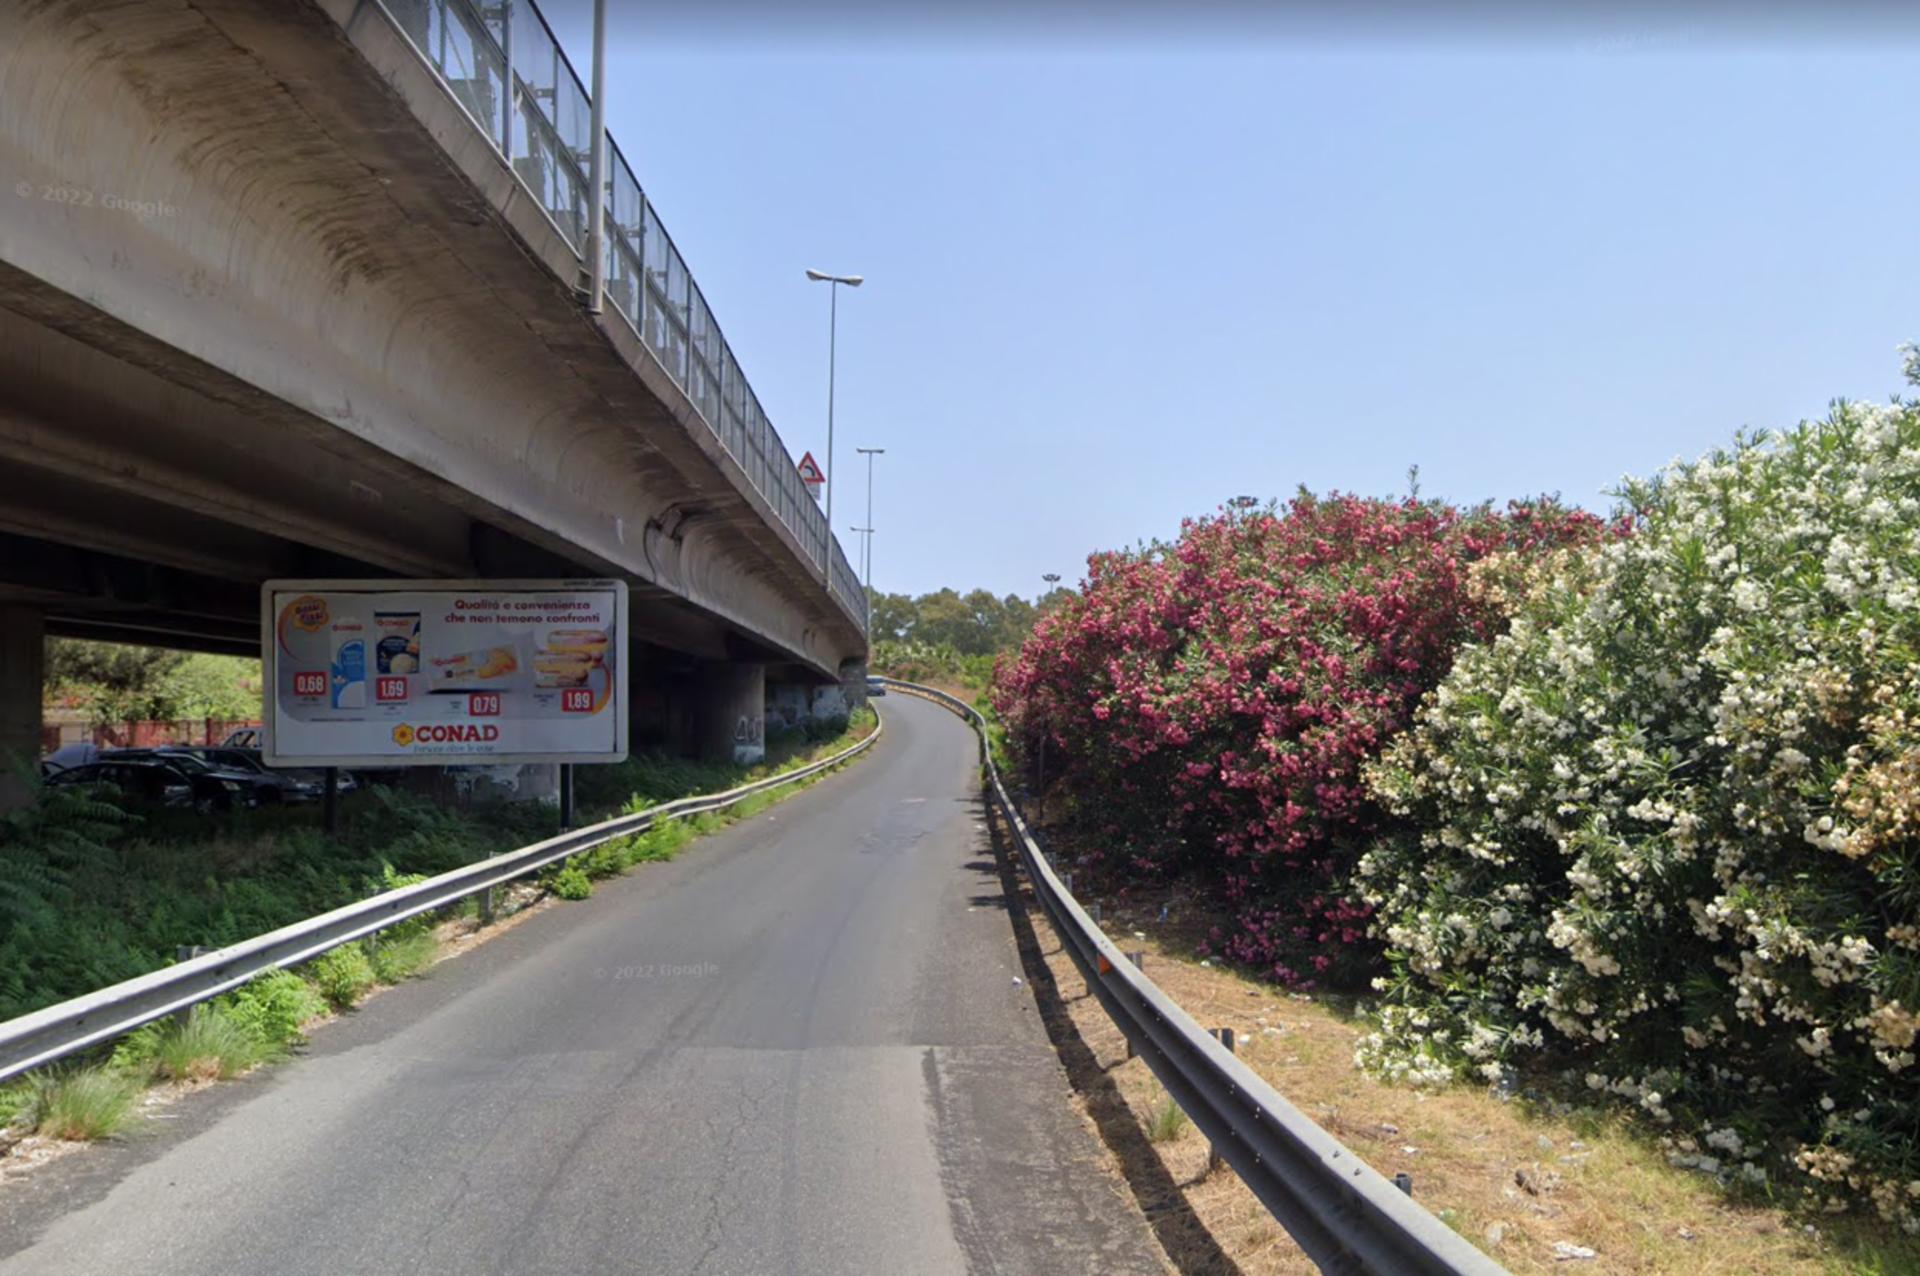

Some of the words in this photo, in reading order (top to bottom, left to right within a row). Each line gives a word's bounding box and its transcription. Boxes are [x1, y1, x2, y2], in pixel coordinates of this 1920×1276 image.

[503, 602, 511, 610] e
[515, 601, 591, 610] convenienza
[445, 613, 465, 623] che
[470, 615, 492, 623] non
[496, 614, 543, 623] temono
[546, 612, 600, 623] confronti
[416, 725, 499, 742] CONAD
